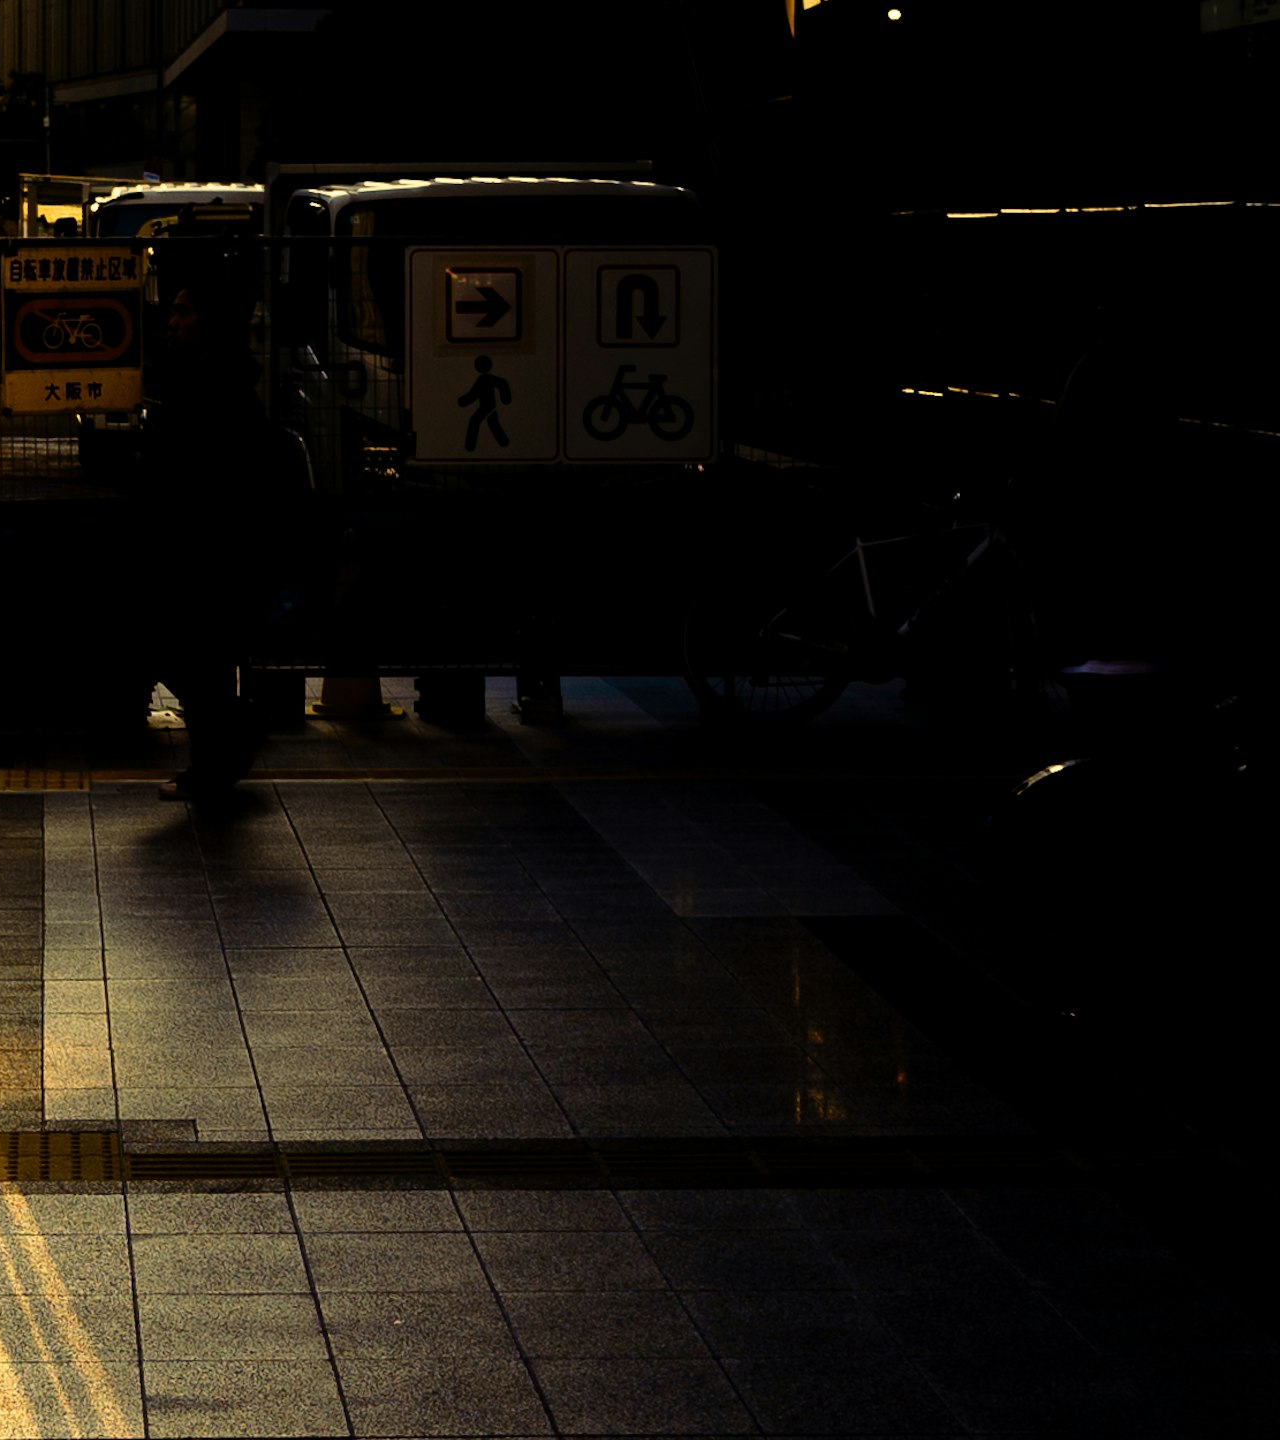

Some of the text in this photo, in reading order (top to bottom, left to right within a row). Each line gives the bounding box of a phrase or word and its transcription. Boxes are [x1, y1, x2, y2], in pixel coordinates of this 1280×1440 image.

[10, 257, 137, 282] 自転車放置禁止区域
[44, 382, 103, 401] 大阪市
